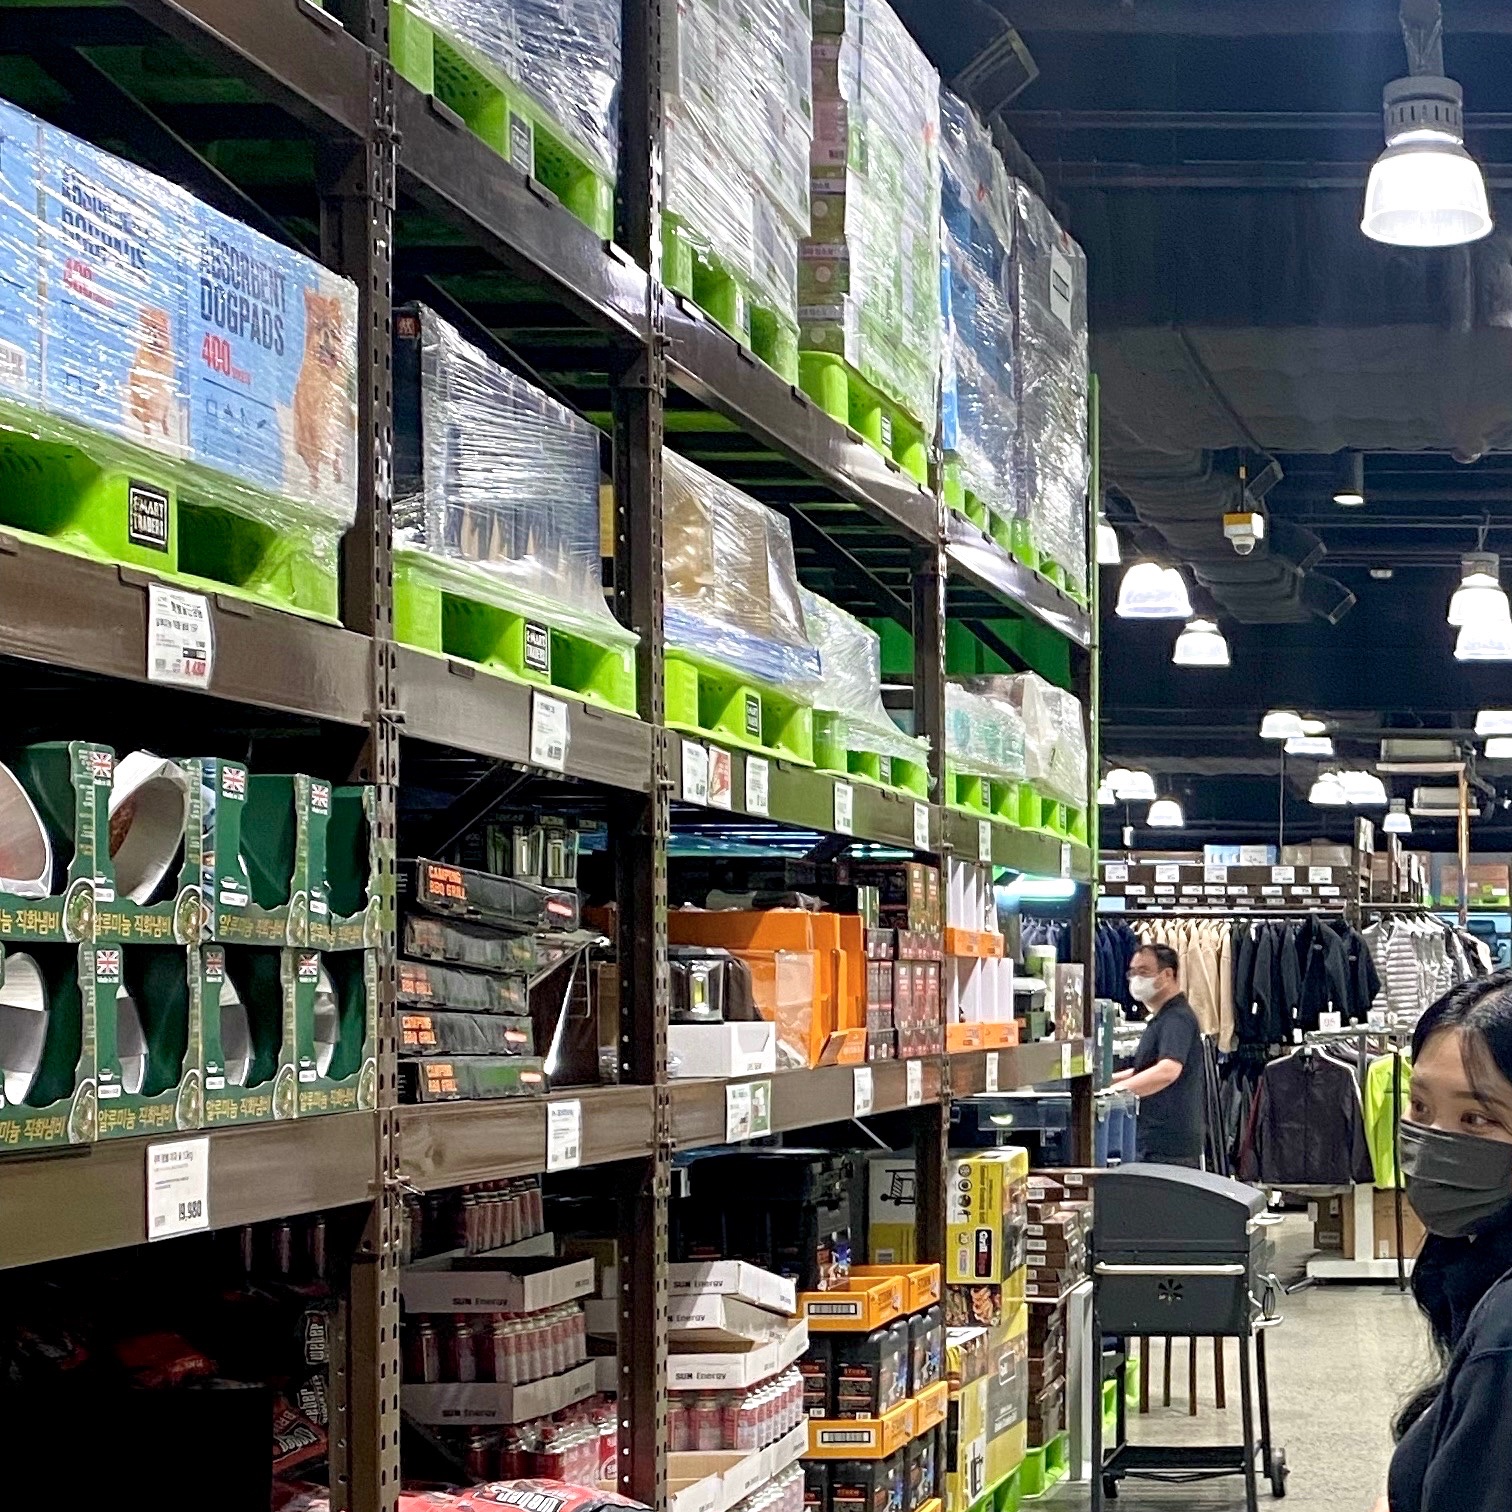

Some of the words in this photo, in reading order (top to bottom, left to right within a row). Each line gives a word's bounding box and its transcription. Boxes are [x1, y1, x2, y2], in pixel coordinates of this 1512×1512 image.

[200, 276, 285, 357] DOGPADS
[202, 332, 232, 376] 400
[15, 909, 60, 936] 직화냄비
[134, 912, 172, 938] 직화냄비
[23, 1117, 66, 1141] 직화냄비
[98, 1105, 136, 1131] 알루미늄
[139, 1104, 174, 1129] 직화냄비
[676, 1313, 705, 1324] Energy
[696, 1370, 727, 1381] Energy
[463, 1408, 497, 1419] Energy
